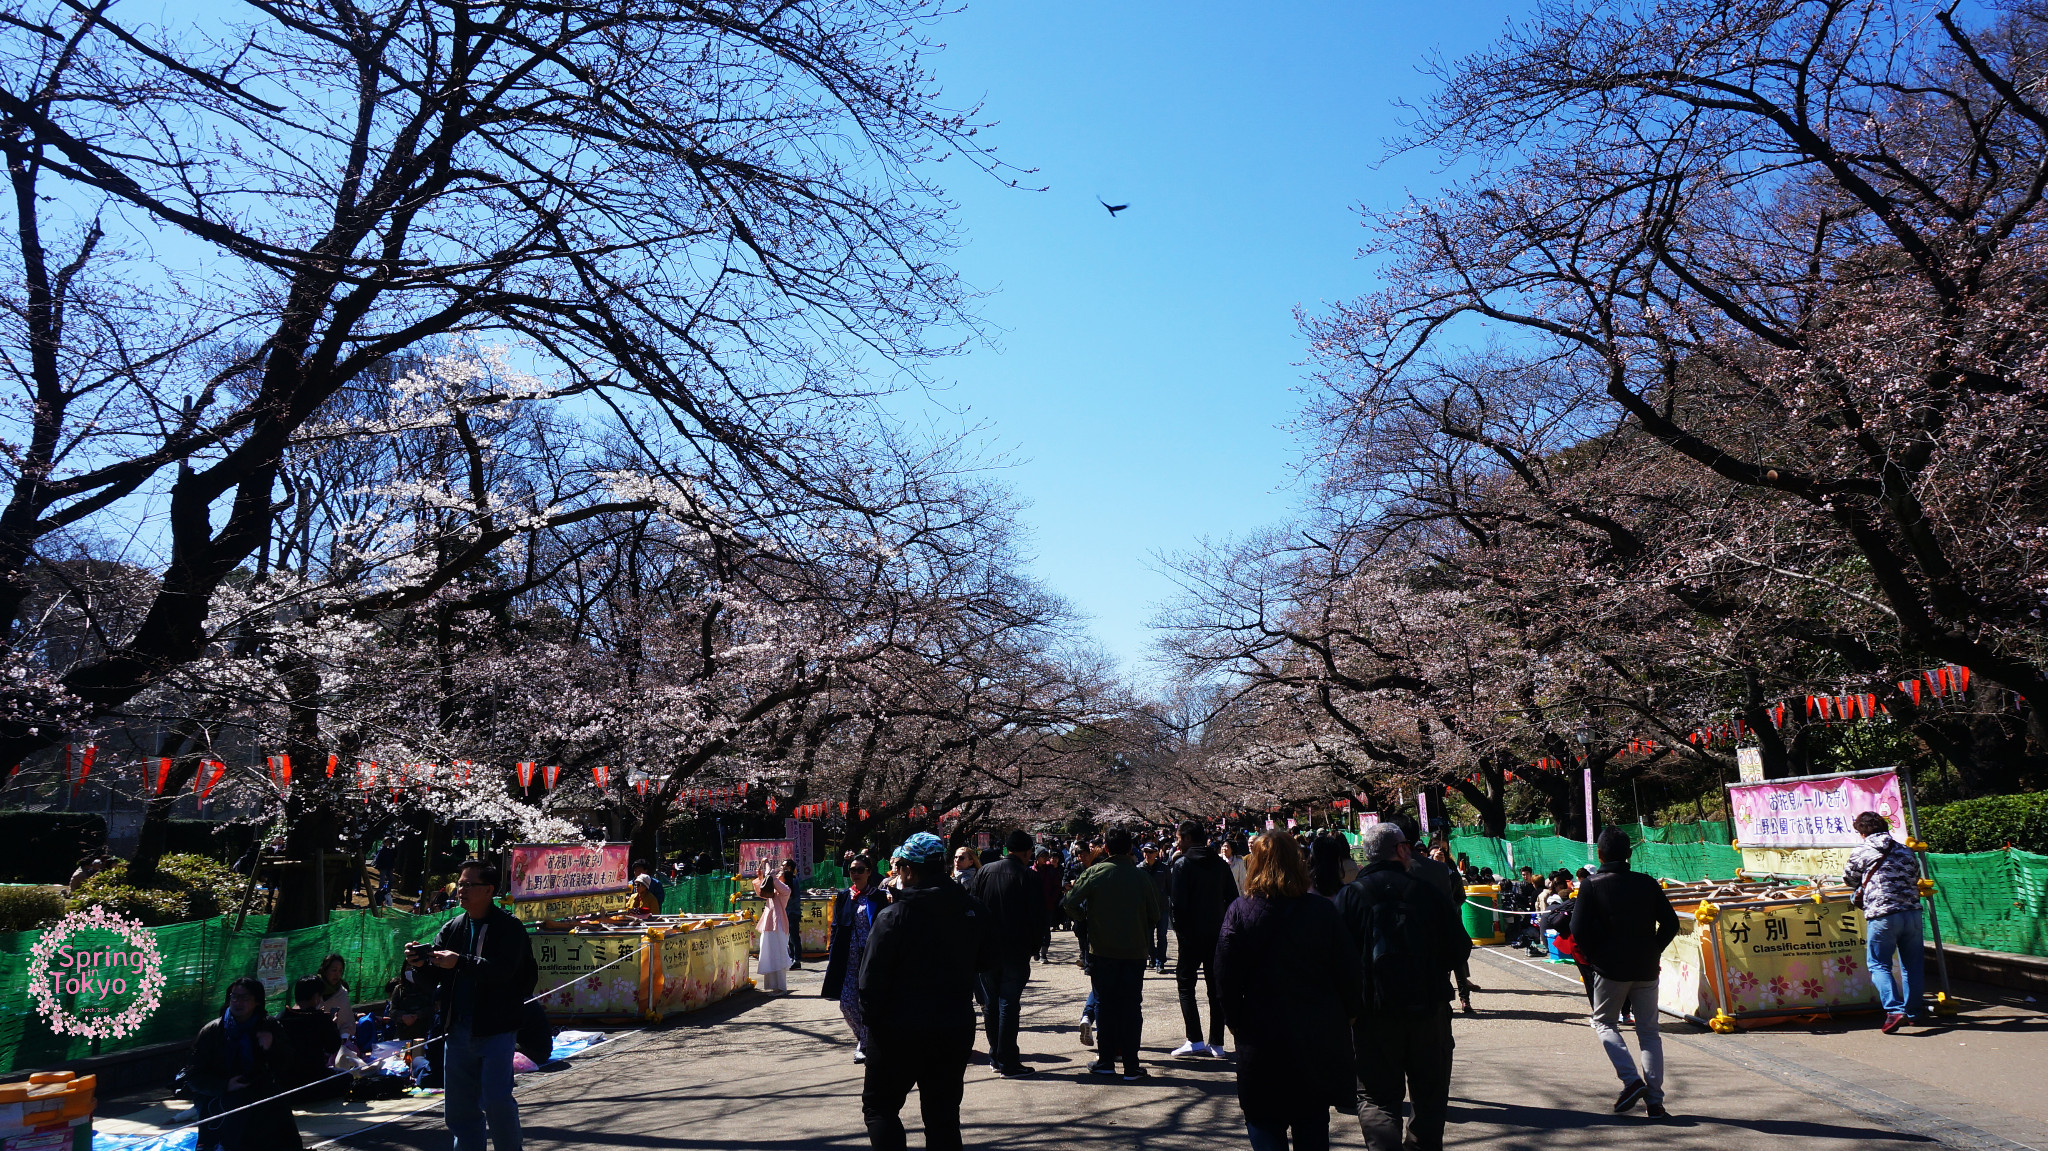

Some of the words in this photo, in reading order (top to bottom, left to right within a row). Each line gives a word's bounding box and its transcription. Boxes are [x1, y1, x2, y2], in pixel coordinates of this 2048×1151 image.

[1769, 789, 1849, 811] お花見ルールを守り
[547, 853, 603, 870] お花見ルールを守り
[1729, 915, 1858, 944] 分別ゴミ
[540, 944, 634, 962] 別ゴミ箱
[1753, 941, 1826, 953] Classification
[1828, 938, 1857, 948] trash
[538, 963, 581, 971] assification
